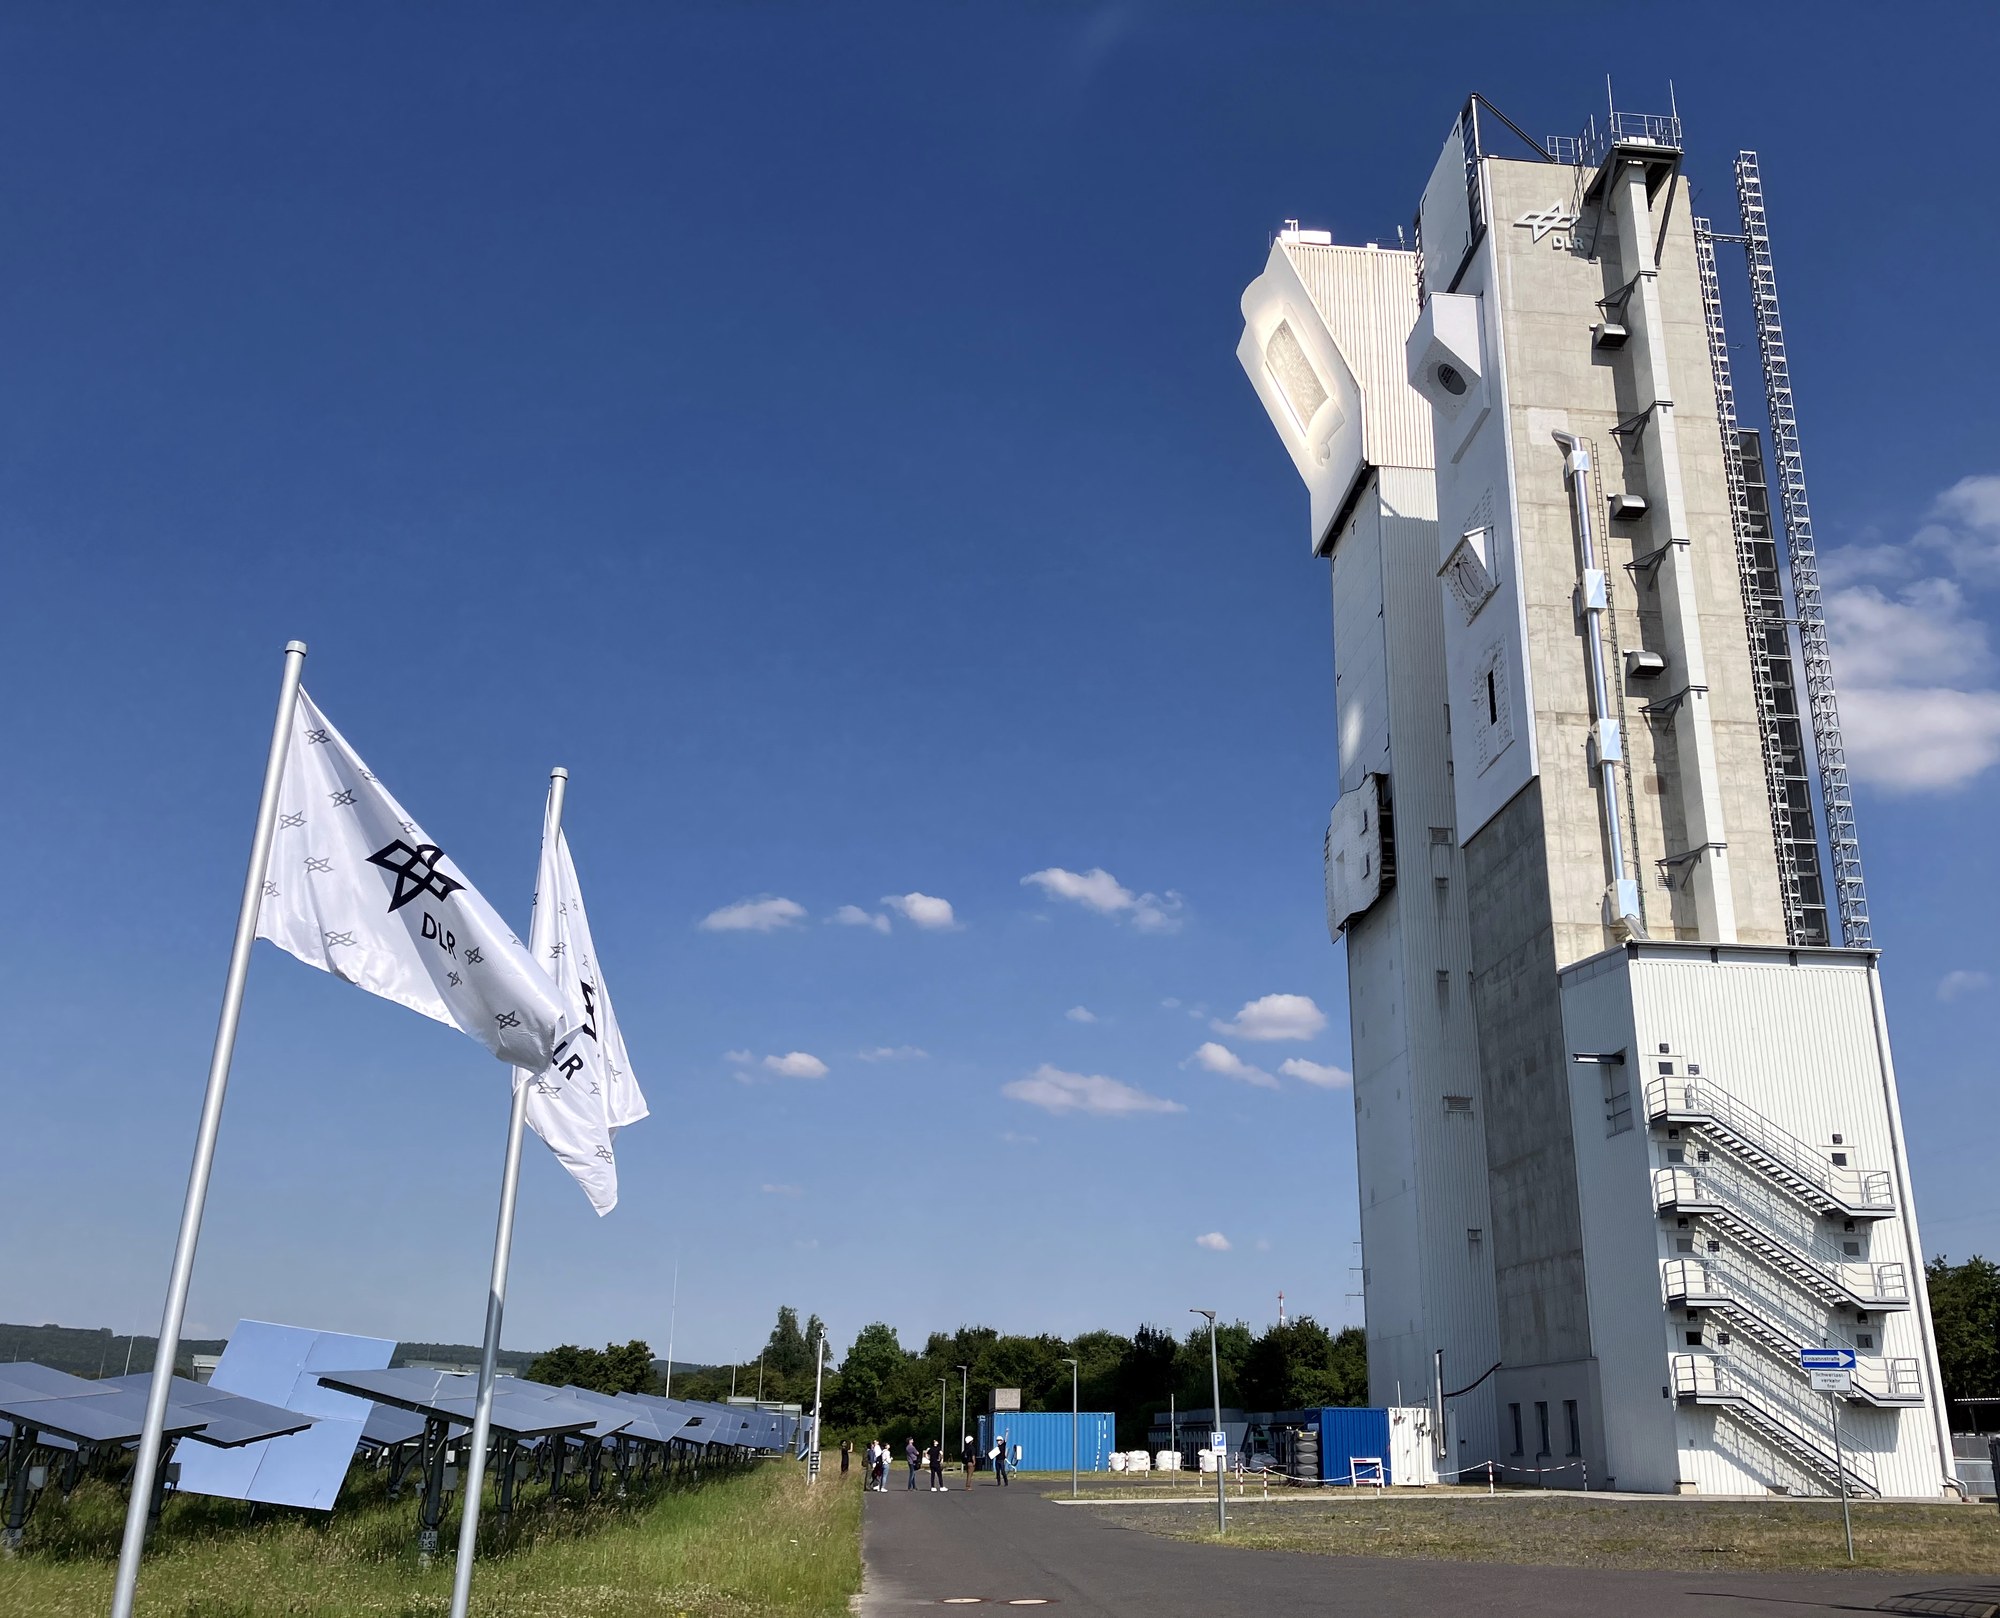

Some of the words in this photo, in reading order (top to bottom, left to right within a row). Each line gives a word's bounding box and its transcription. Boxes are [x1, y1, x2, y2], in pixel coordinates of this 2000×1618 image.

[1552, 235, 1584, 251] DLR
[421, 911, 457, 960] DLR
[552, 1040, 584, 1080] LR
[1214, 1434, 1223, 1446] P
